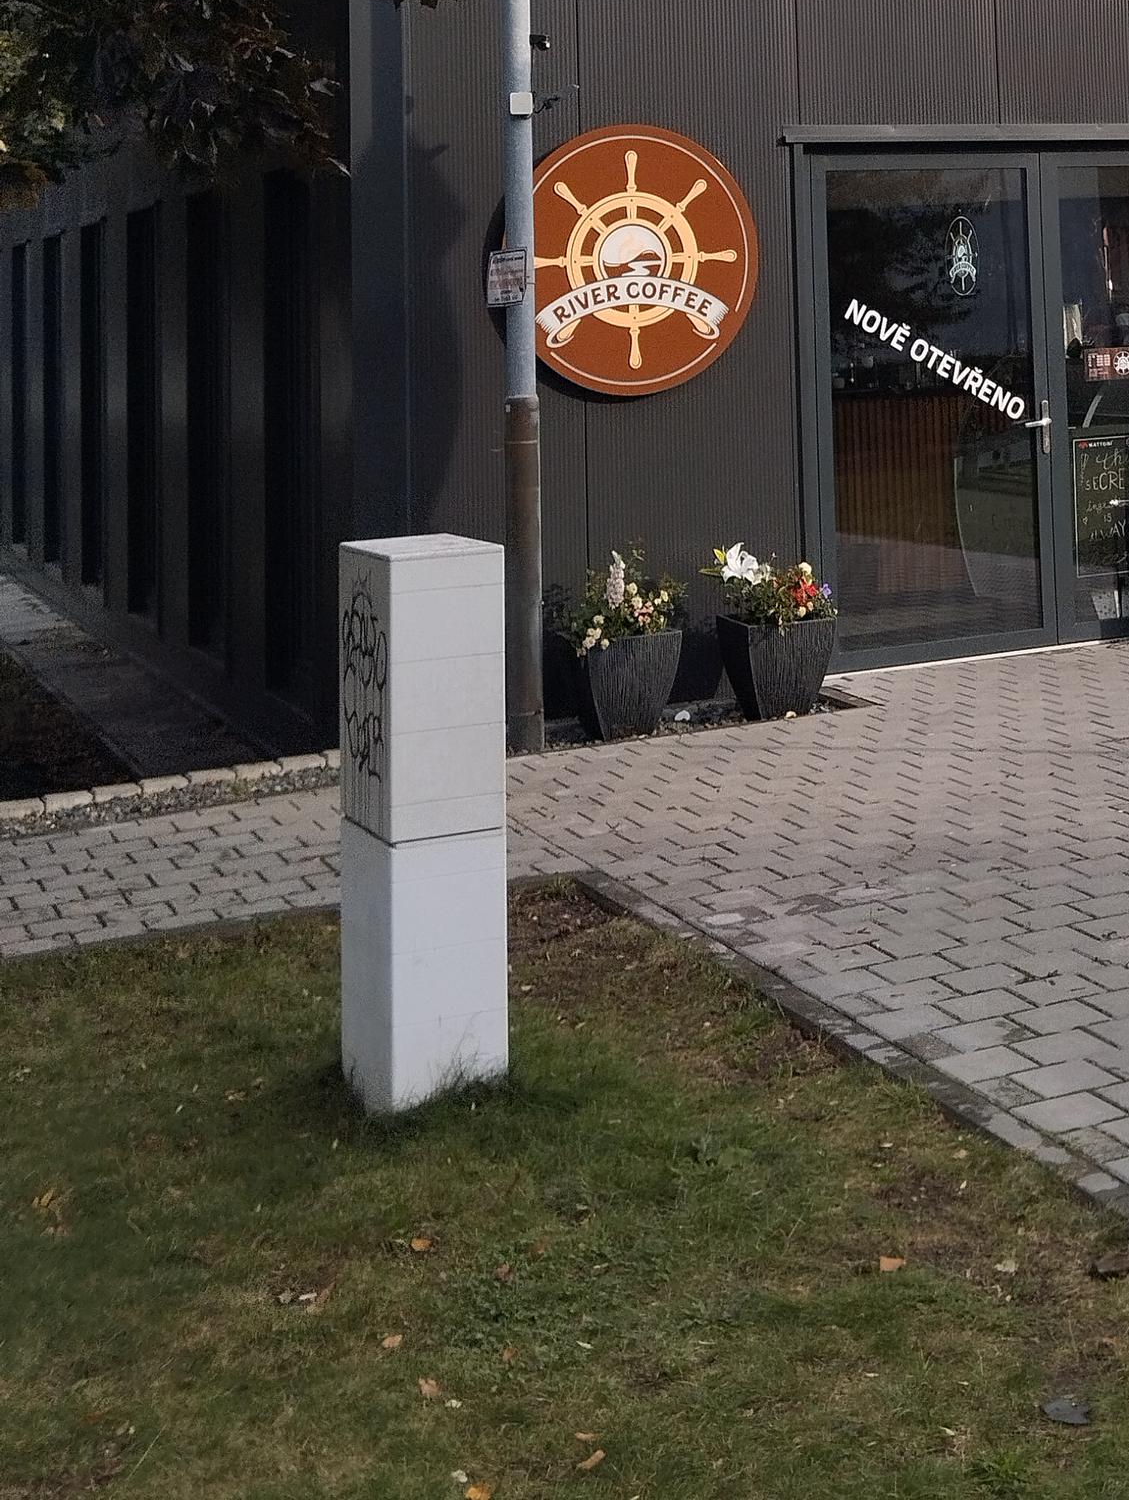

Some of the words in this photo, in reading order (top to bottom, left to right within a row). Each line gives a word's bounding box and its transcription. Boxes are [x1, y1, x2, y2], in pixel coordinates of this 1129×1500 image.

[552, 284, 621, 324] RIVER
[626, 281, 713, 318] COFFEE
[844, 298, 912, 352] NOVĚ
[910, 338, 1026, 420] OTEVŘENO
